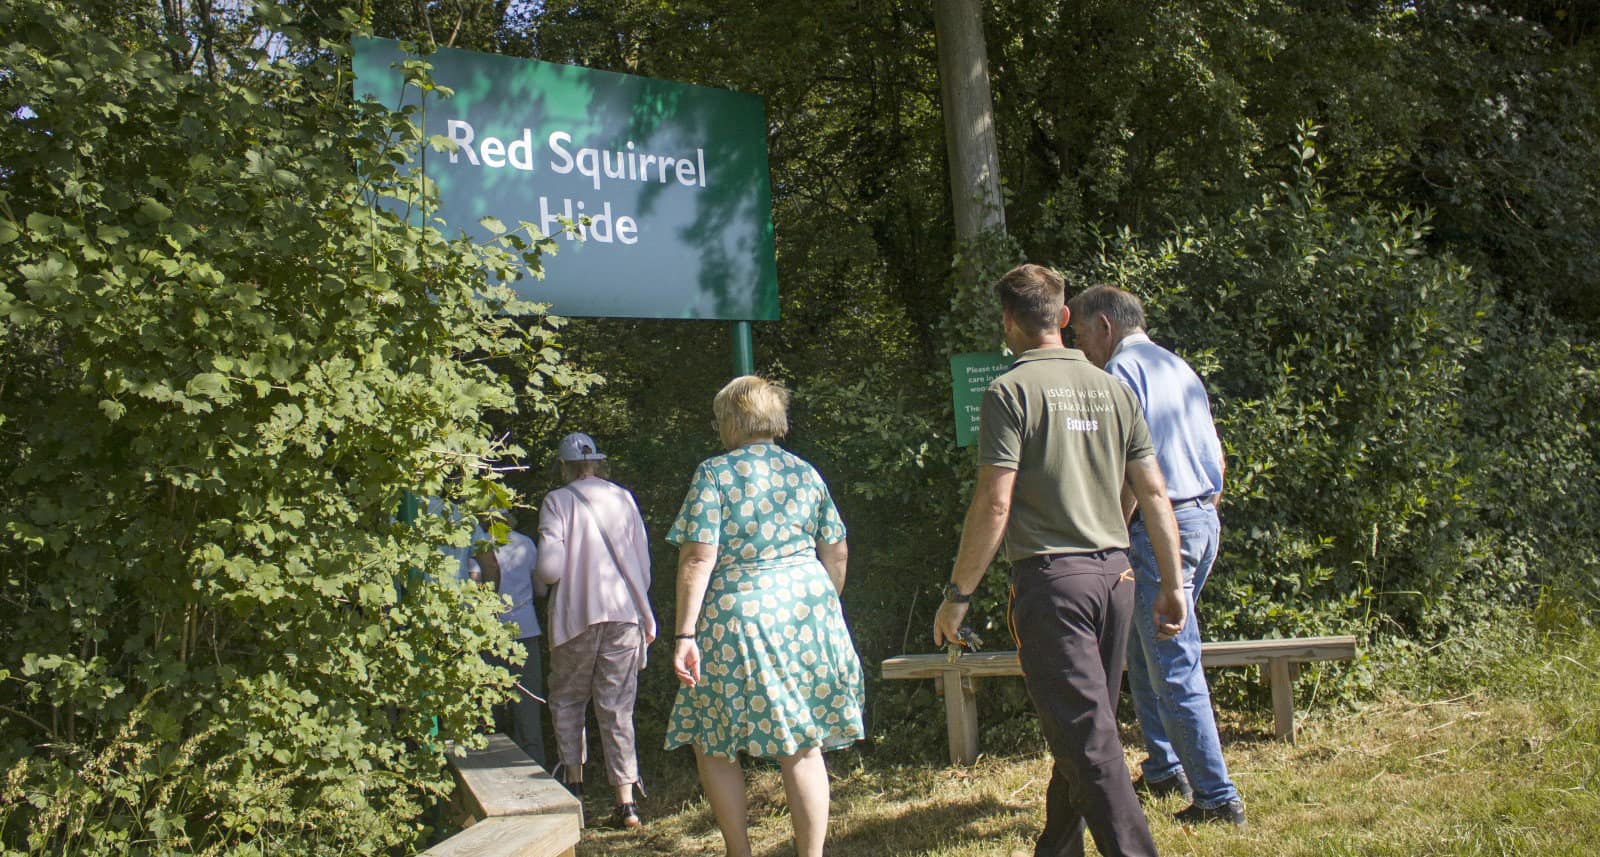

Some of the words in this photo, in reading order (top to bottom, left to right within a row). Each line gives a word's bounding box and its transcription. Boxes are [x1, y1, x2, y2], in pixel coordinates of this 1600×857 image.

[447, 119, 534, 171] Red
[549, 130, 706, 190] Squirrel
[539, 196, 639, 245] Hide
[966, 366, 990, 374] Please
